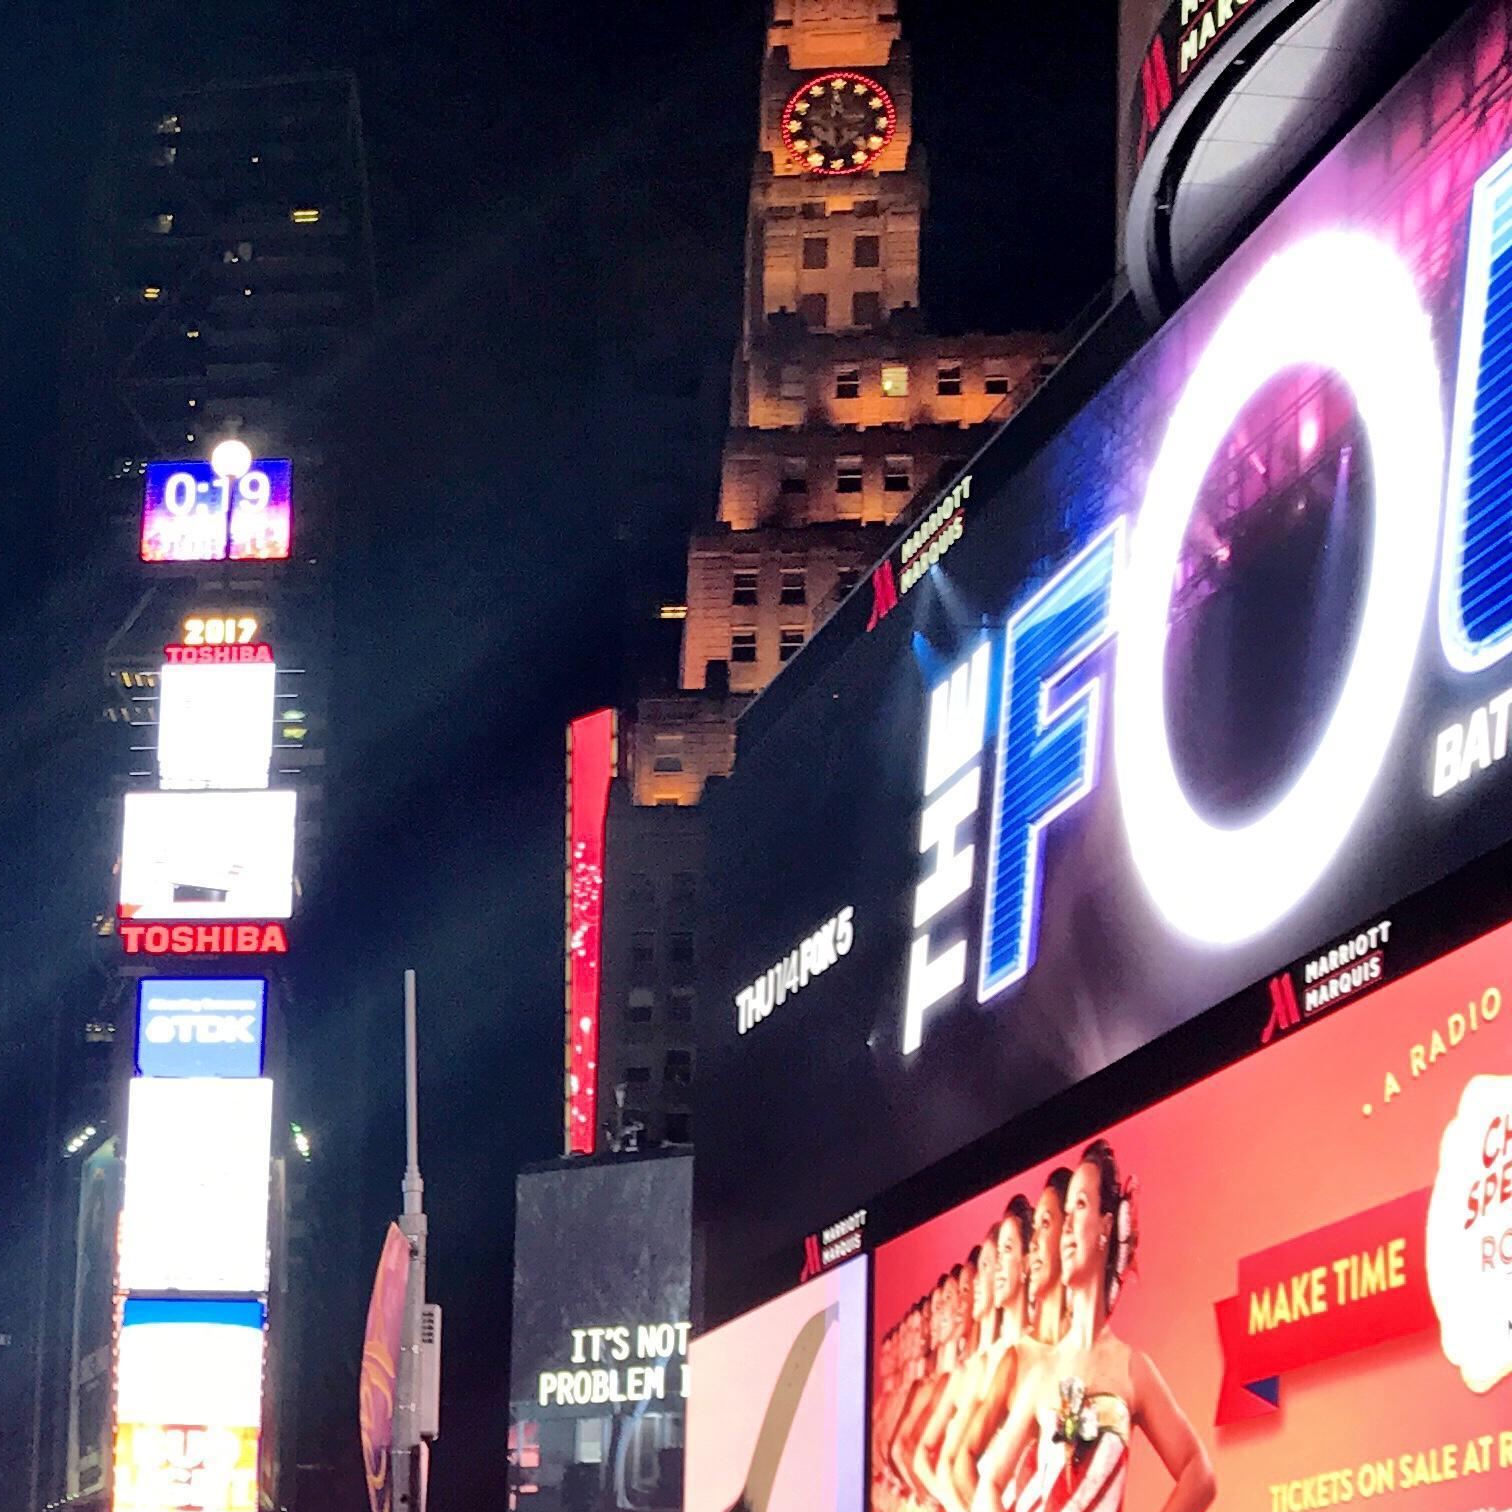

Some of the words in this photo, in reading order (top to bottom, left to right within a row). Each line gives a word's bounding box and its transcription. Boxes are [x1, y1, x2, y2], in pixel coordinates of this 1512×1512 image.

[1180, 0, 1251, 74] MAR
[165, 471, 270, 516] 0:19
[901, 475, 973, 563] MARRIOTT
[899, 516, 964, 594] MARQUIS
[164, 646, 273, 664] TOSHIBA
[183, 618, 258, 644] 2017
[120, 925, 287, 953] TOSHIBA
[1305, 920, 1392, 985] MARRIOTT
[736, 985, 775, 1034] THU
[1305, 956, 1382, 1012] MARQUIS
[1384, 1072, 1401, 1103] A
[1409, 988, 1502, 1077] RADIO
[1248, 1266, 1329, 1336] MAKE
[1333, 1238, 1407, 1306] TIME
[571, 1325, 630, 1364] IT'S
[637, 1321, 692, 1358] NOT
[539, 1364, 665, 1407] PROBLEM
[1357, 1457, 1395, 1498] ON
[1399, 1444, 1459, 1489] SALE
[1461, 1435, 1494, 1476] AT
